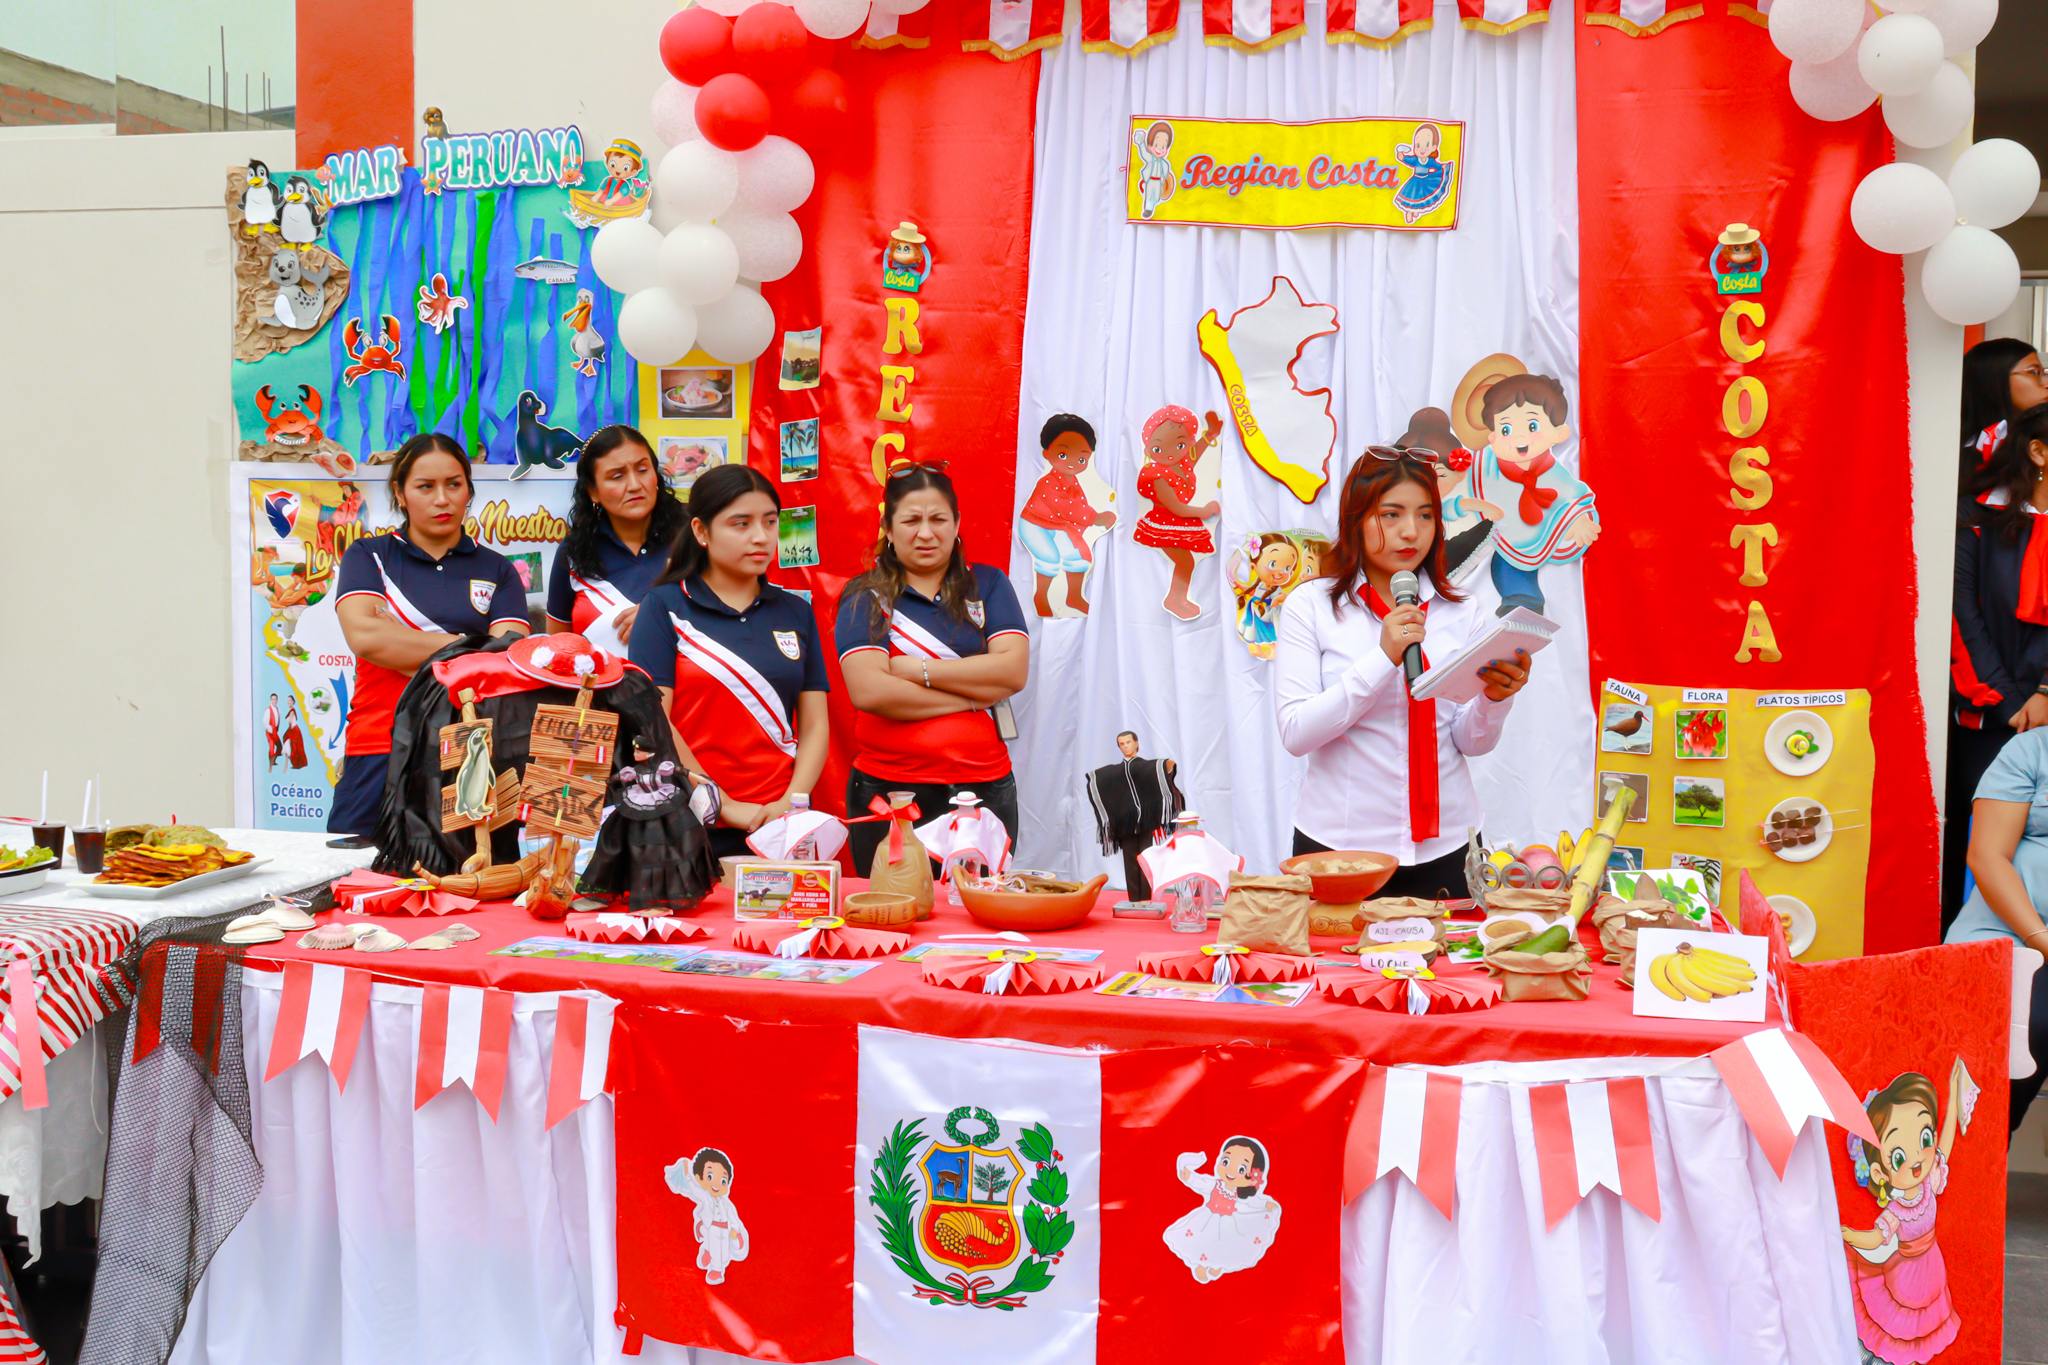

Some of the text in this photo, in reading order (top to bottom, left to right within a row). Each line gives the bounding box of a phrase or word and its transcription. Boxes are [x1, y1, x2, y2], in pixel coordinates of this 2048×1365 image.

[325, 125, 584, 206] MAR PERUANO
[1179, 153, 1400, 197] Region Costa
[885, 270, 915, 288] Costa
[1721, 275, 1758, 292] Costa
[1230, 384, 1258, 437] COSTA
[1719, 300, 1783, 664] COSTA
[479, 499, 568, 546] Nuestra
[305, 541, 333, 584] La
[318, 654, 354, 667] COSTA
[1609, 682, 1641, 702] FAUNA
[1687, 691, 1723, 701] FLORA
[1757, 694, 1843, 706] PLATOS TÍPICOS
[271, 783, 323, 799] Océano
[270, 802, 324, 818] Pacifico
[1374, 926, 1425, 936] AJI CAUSA
